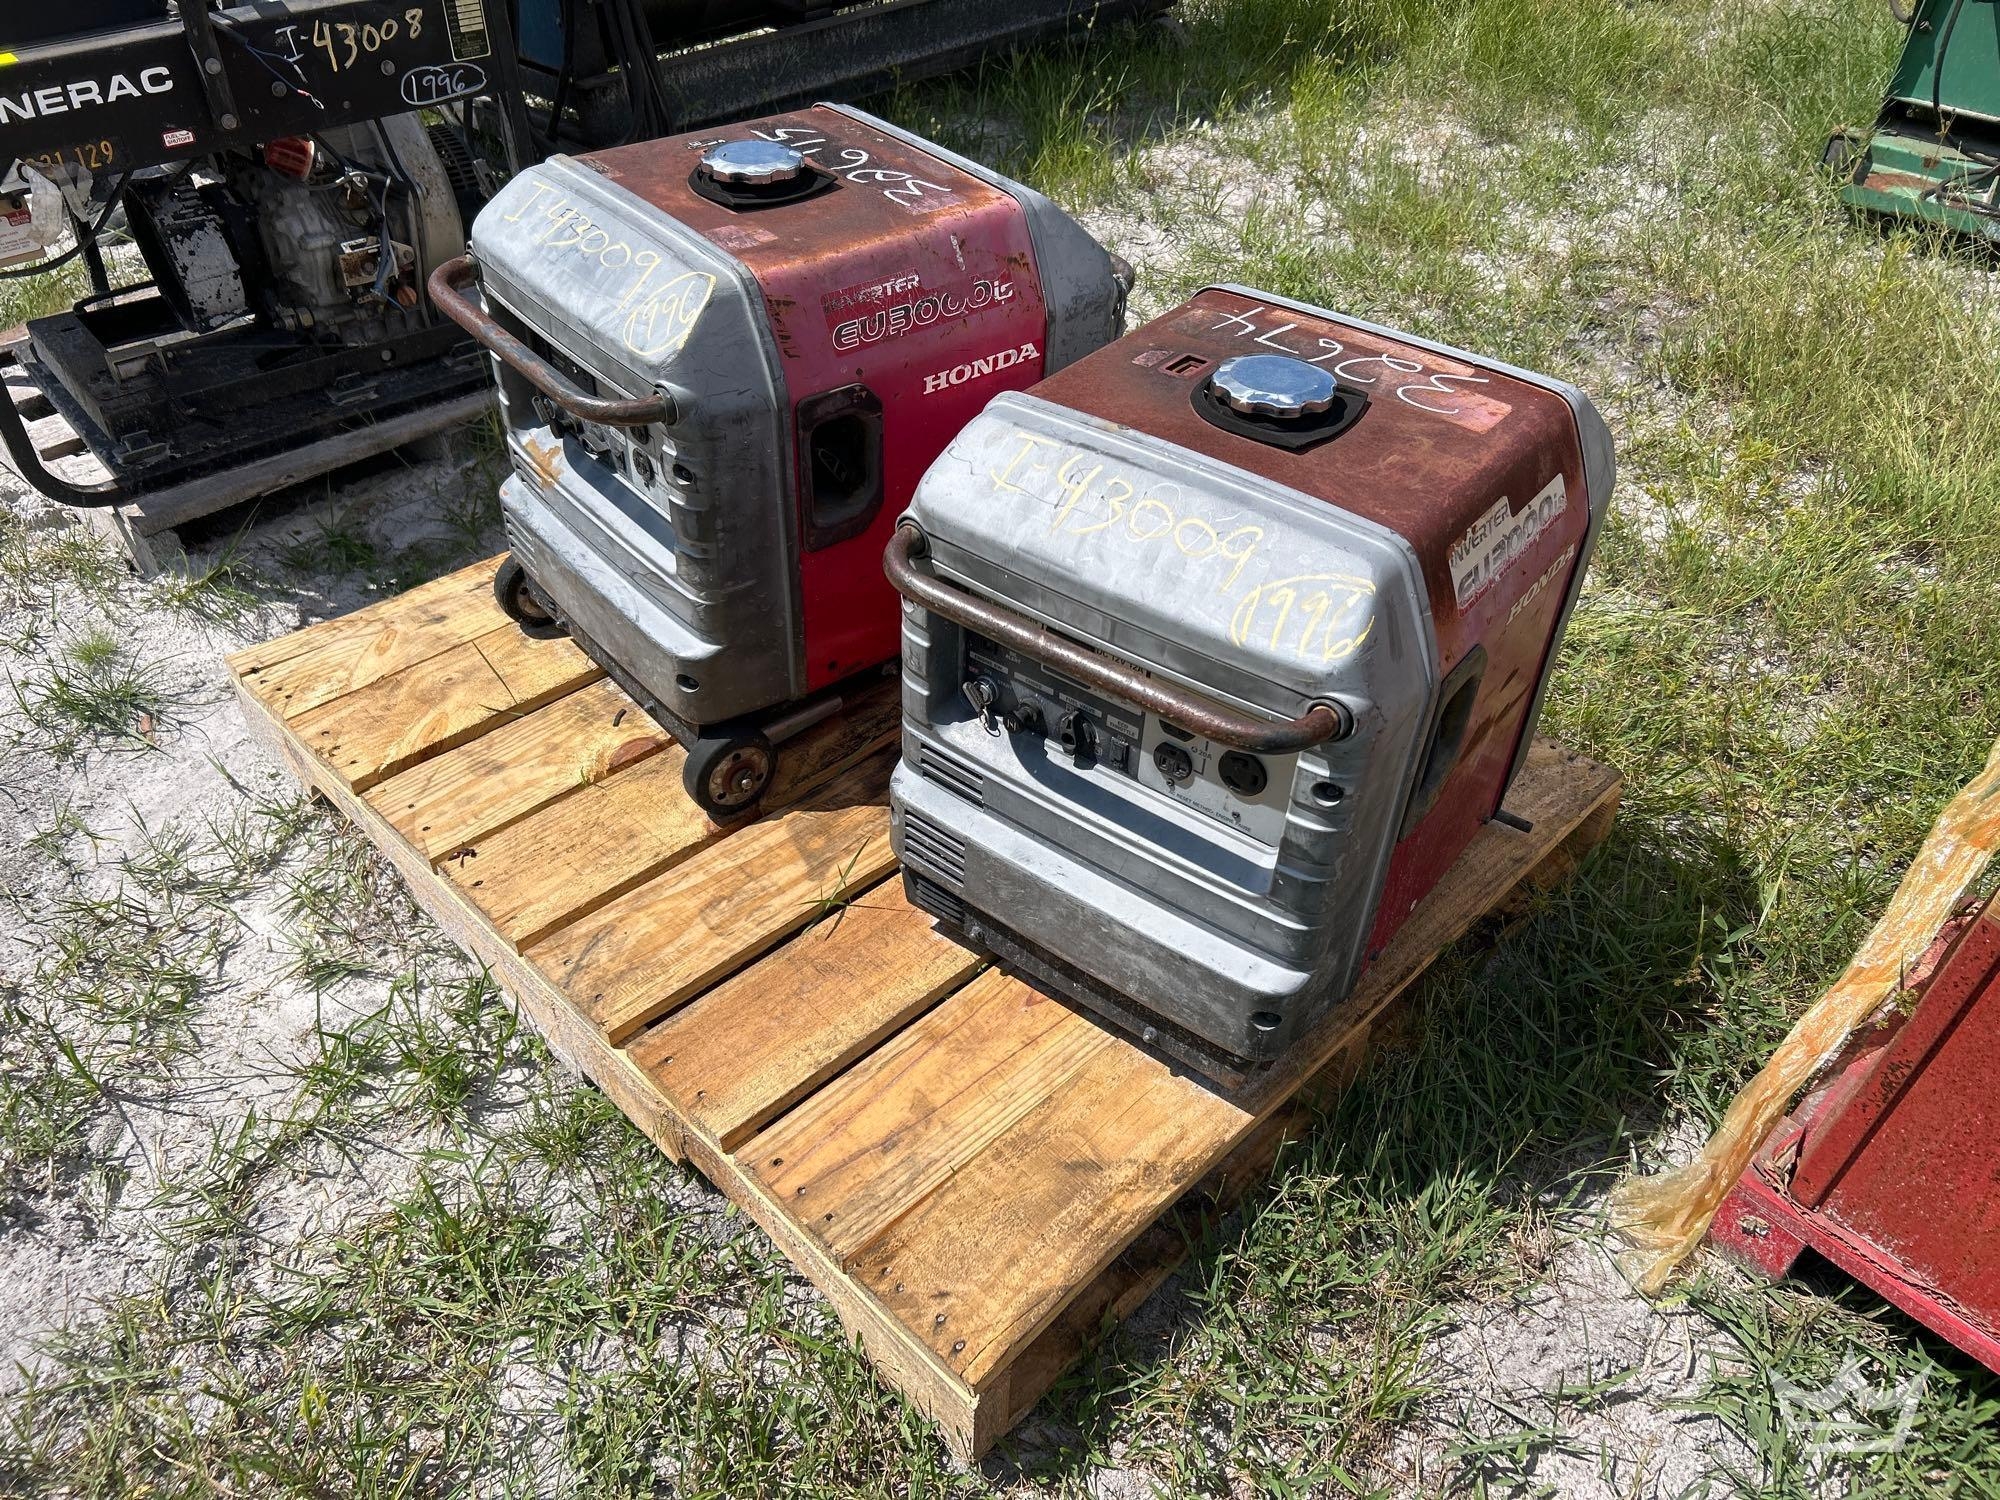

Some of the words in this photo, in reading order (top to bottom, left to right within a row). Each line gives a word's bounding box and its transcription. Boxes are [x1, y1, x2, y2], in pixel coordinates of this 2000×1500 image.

[0, 66, 174, 124] NERAC
[410, 69, 466, 104] 1996
[165, 133, 179, 141] FUEL
[167, 136, 191, 145] SHUTOFF
[824, 274, 920, 313] ERTER
[922, 342, 1041, 395] HONDA
[1212, 307, 1489, 414] 32674
[1450, 501, 1509, 568] INVERTER
[1506, 543, 1575, 626] HONDA
[1109, 721, 1135, 736] THROTTLE
[1117, 720, 1129, 729] ECO
[1199, 750, 1212, 761] 20A
